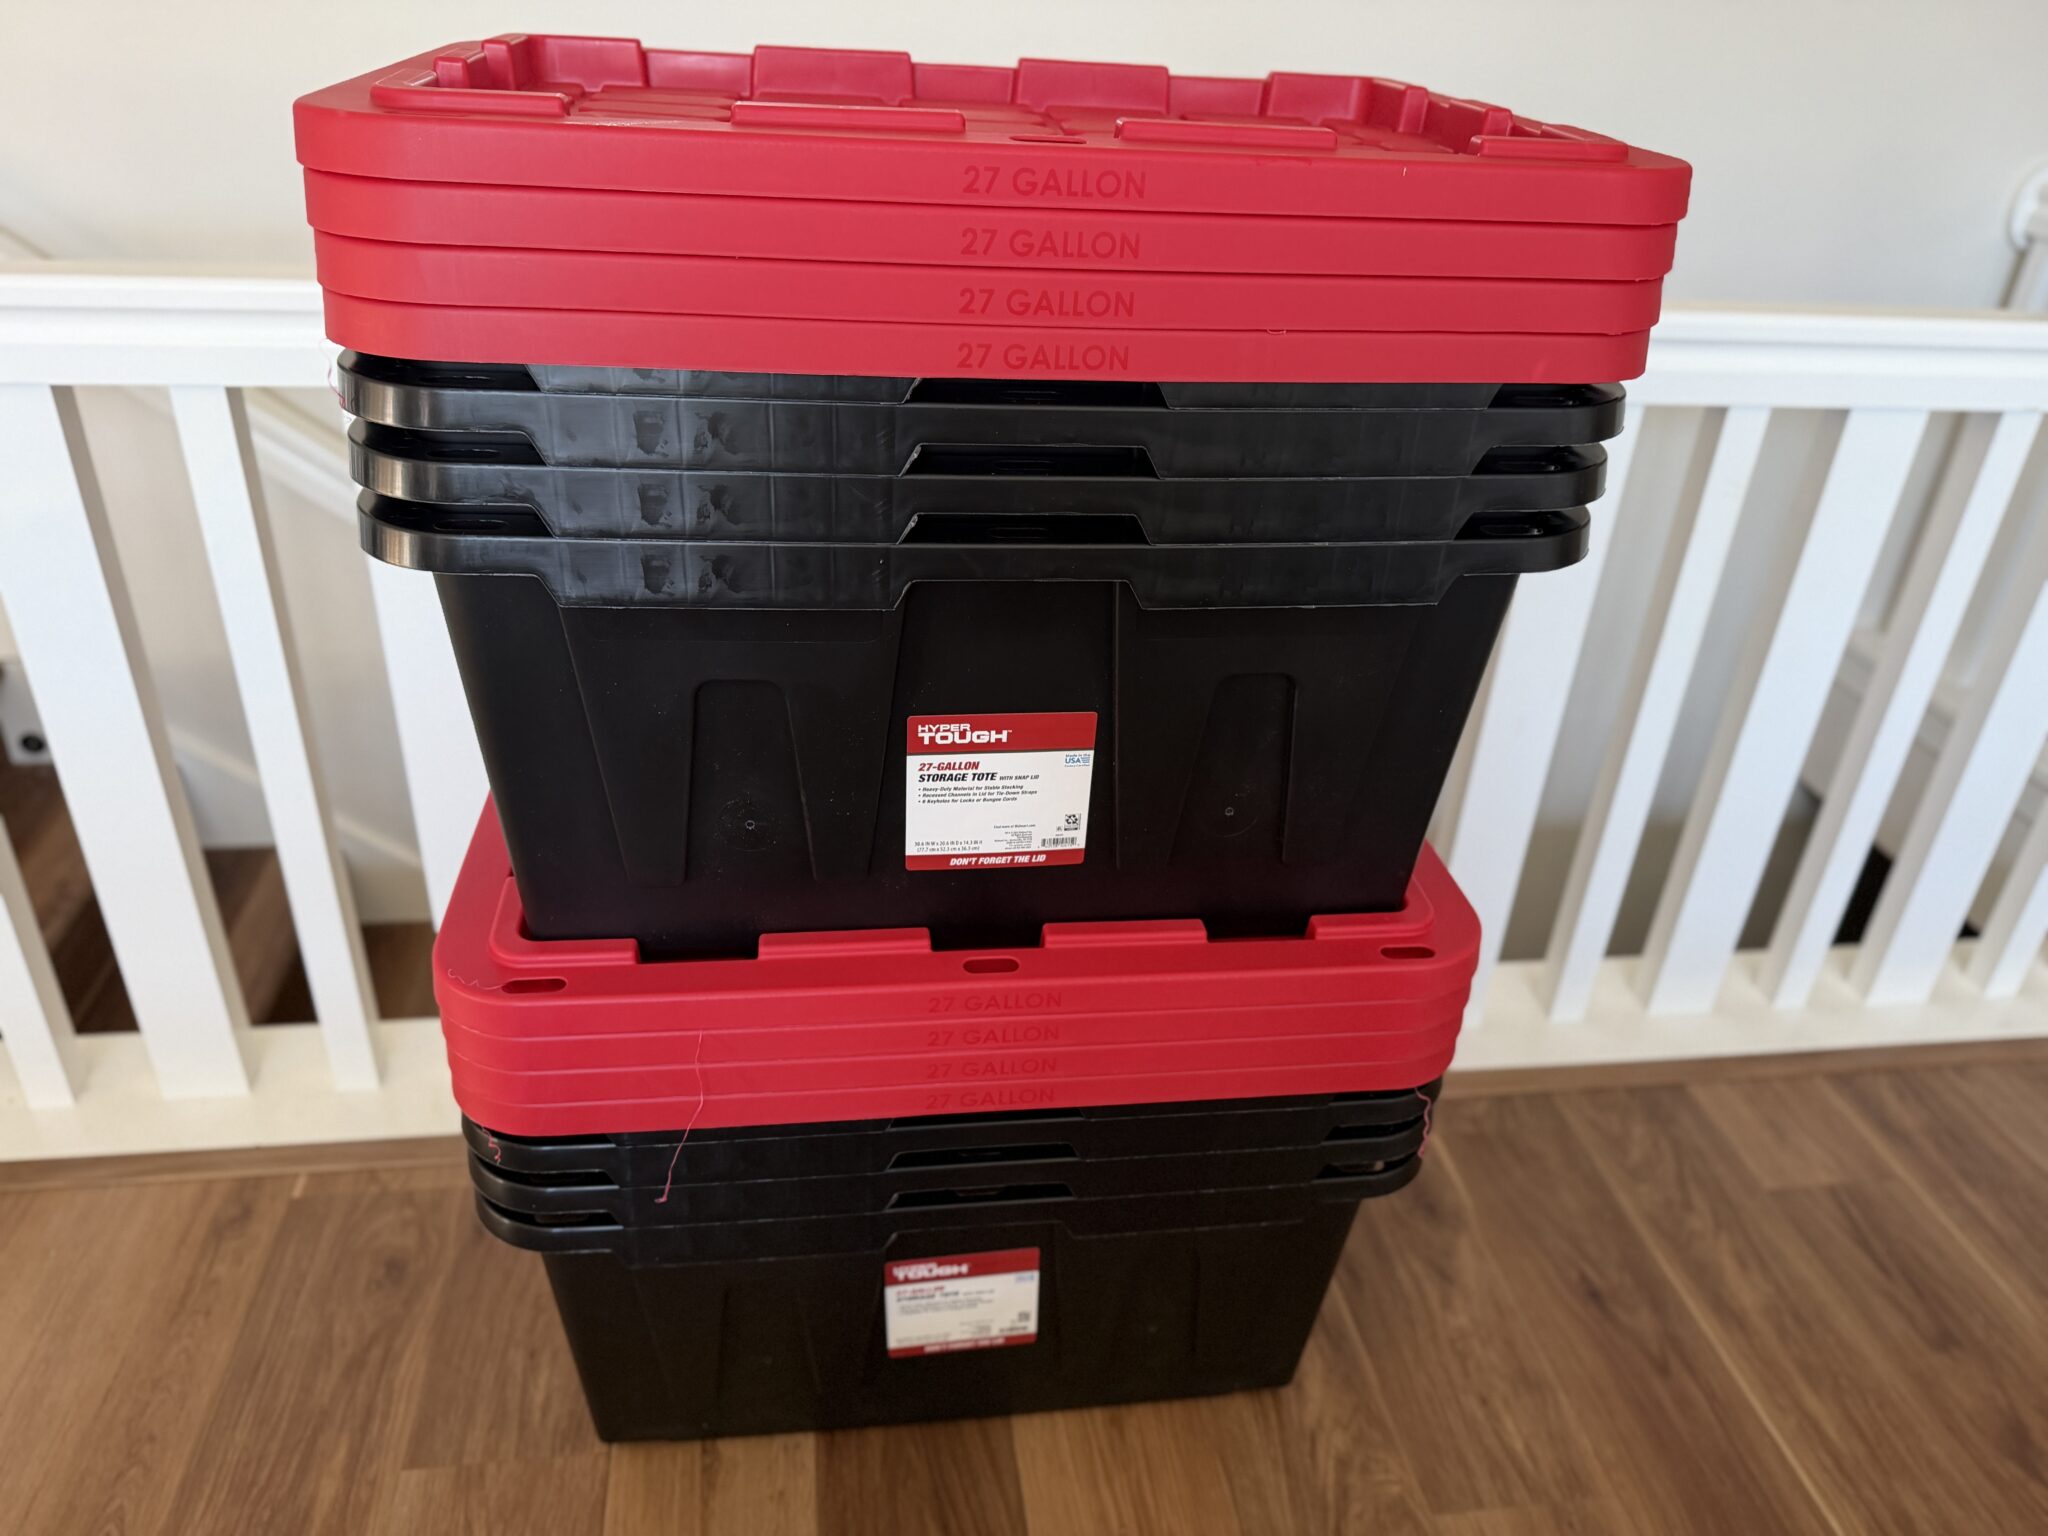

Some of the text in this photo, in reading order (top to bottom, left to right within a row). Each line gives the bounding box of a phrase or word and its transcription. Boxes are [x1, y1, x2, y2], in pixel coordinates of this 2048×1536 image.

[962, 165, 1146, 199] 27 GALLON
[960, 227, 1140, 259] 27 GALLON
[958, 287, 1135, 318] 27 GALLON
[956, 342, 1129, 371] 27 GALLON
[918, 723, 971, 733] HYPER
[918, 761, 980, 772] 27-GALLON
[918, 773, 969, 783] STORAGE
[971, 772, 998, 782] TOTE
[949, 854, 1047, 866] DON'T FORGET THE LID
[928, 992, 1062, 1013] 27 GALLON
[927, 1026, 1059, 1047] 27 GALLON
[927, 1058, 1057, 1079] 27 GALLON
[925, 1088, 1055, 1110] 27 GALLON
